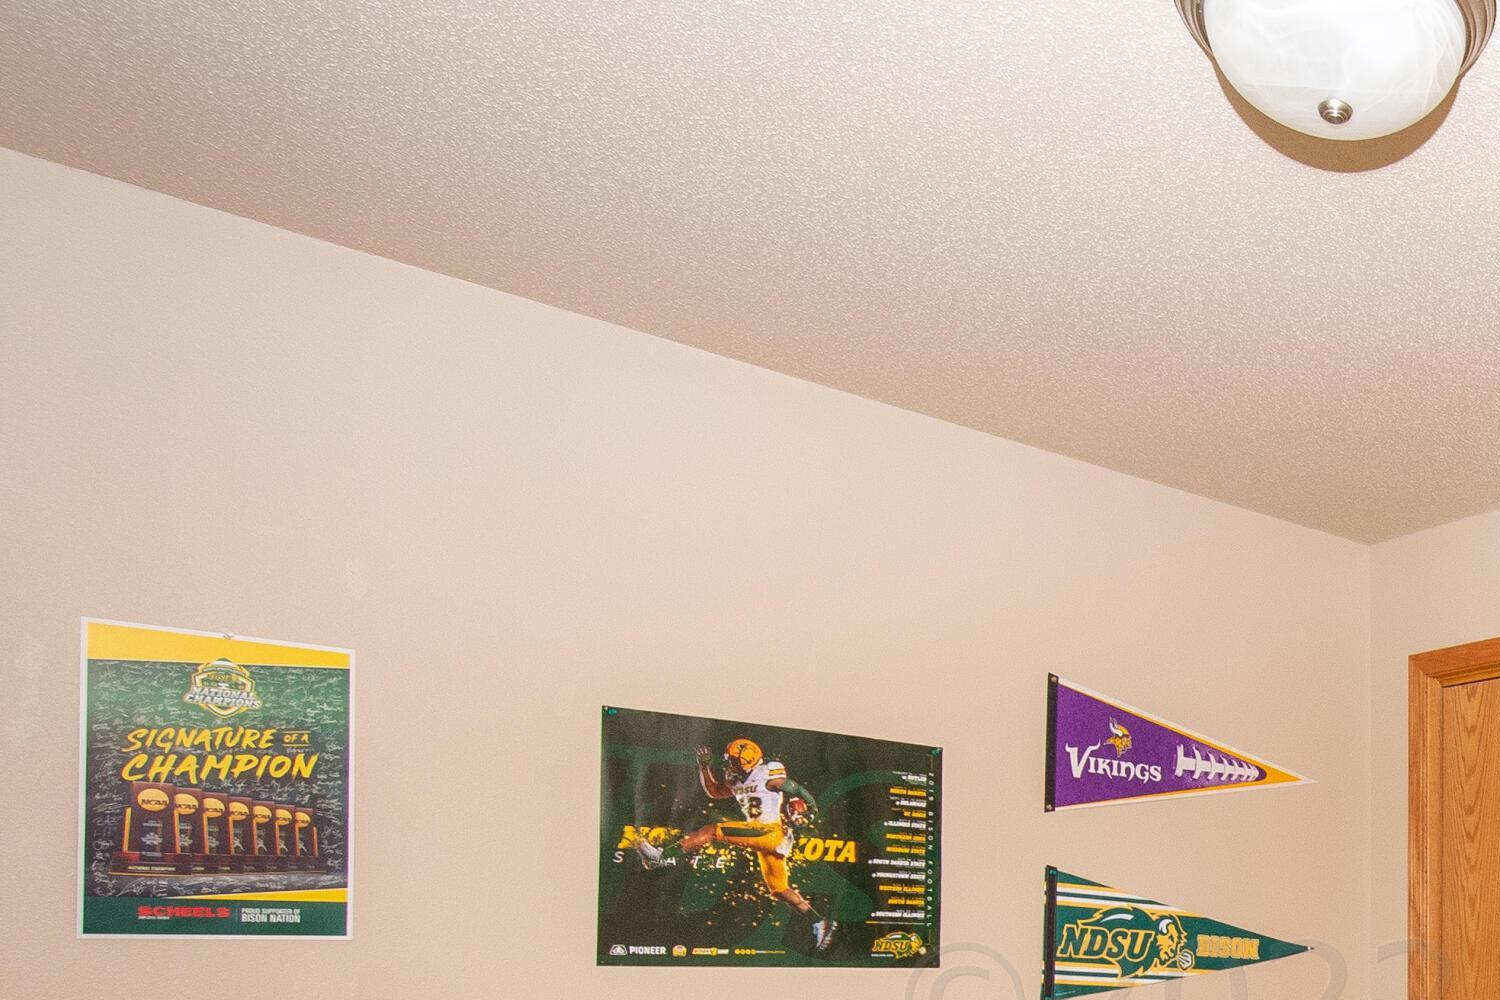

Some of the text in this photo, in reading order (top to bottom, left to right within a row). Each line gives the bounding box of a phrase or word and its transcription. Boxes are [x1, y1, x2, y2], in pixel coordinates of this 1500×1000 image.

[121, 725, 310, 753] SIGNATURE OF A
[121, 752, 320, 785] CHAMPION
[612, 850, 727, 869] SATE
[137, 905, 230, 918] SCHEELS
[241, 913, 301, 923] BISON NATION
[629, 945, 667, 955] PIONEER
[871, 939, 910, 952] NDSU
[1056, 923, 1155, 962] NDSU
[1196, 934, 1260, 960] BISON
